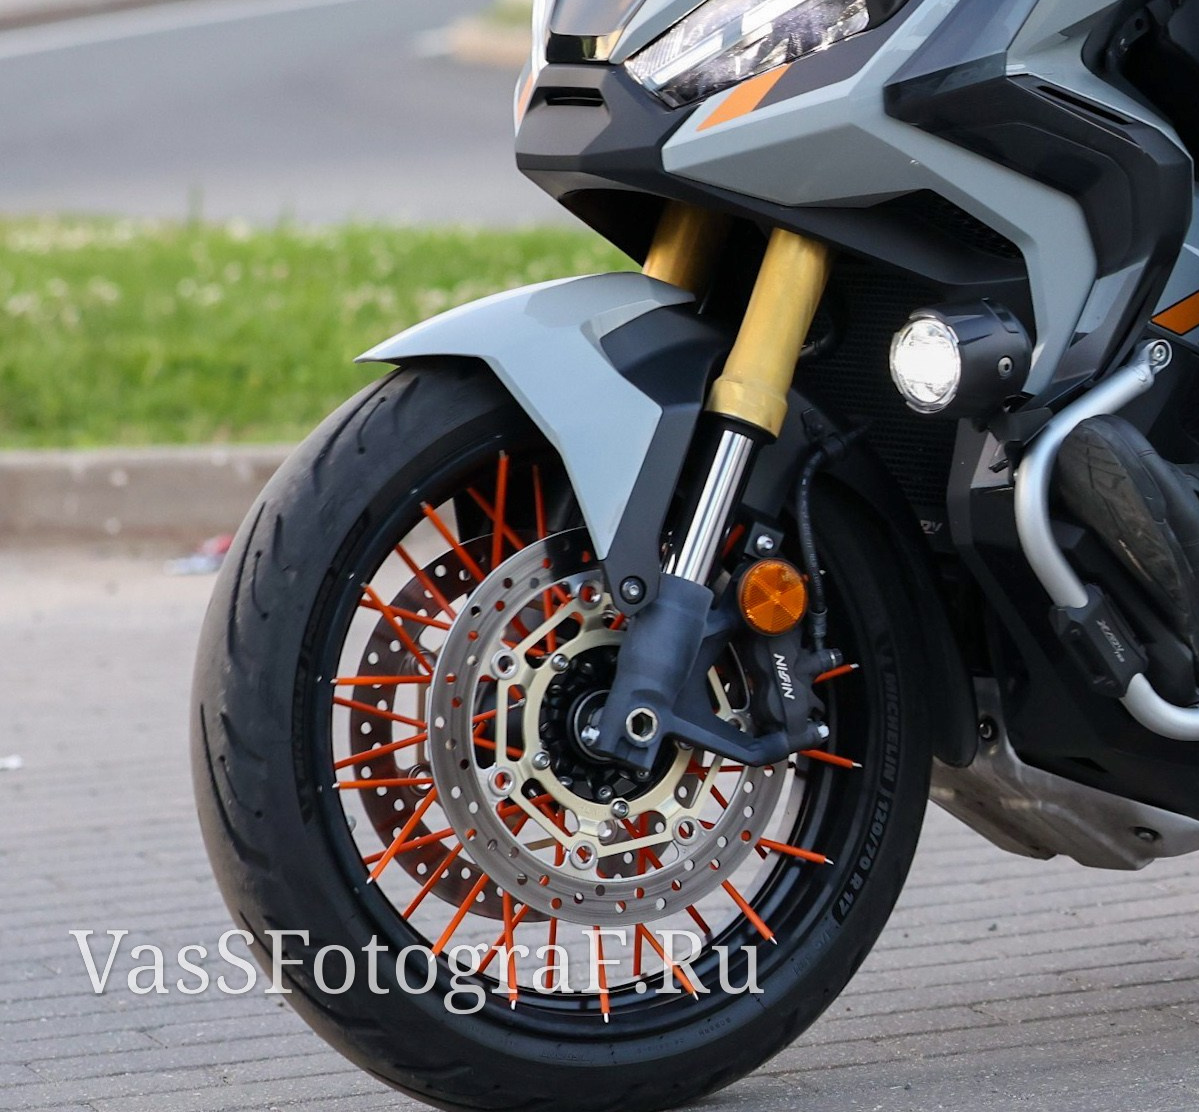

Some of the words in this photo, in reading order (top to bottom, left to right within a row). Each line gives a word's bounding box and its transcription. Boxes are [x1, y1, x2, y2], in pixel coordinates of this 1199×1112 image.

[882, 672, 900, 783] MICHELIN
[858, 796, 890, 871] 120/70
[839, 892, 856, 916] 17
[849, 875, 865, 892] R
